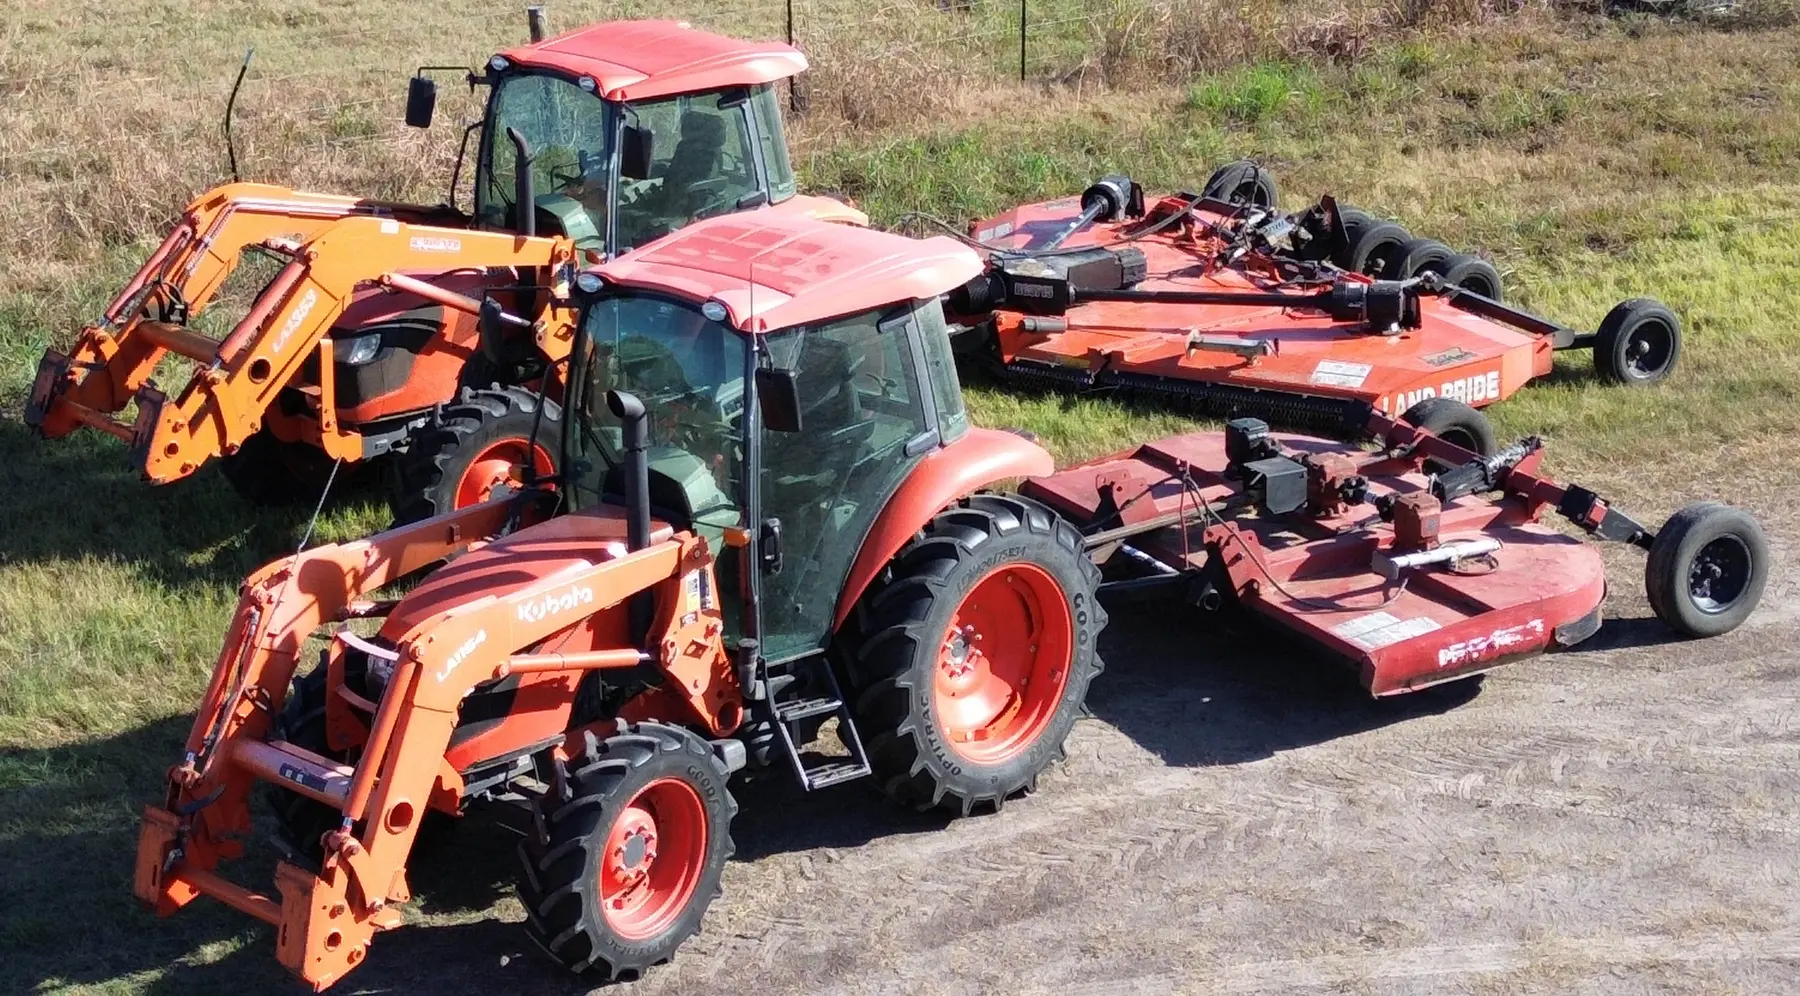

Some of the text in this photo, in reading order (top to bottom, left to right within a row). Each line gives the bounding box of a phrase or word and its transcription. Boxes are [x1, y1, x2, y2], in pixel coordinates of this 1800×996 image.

[1441, 371, 1499, 405] PRIDE
[516, 584, 593, 623] Kubota
[920, 696, 962, 776] OPTITRAC
